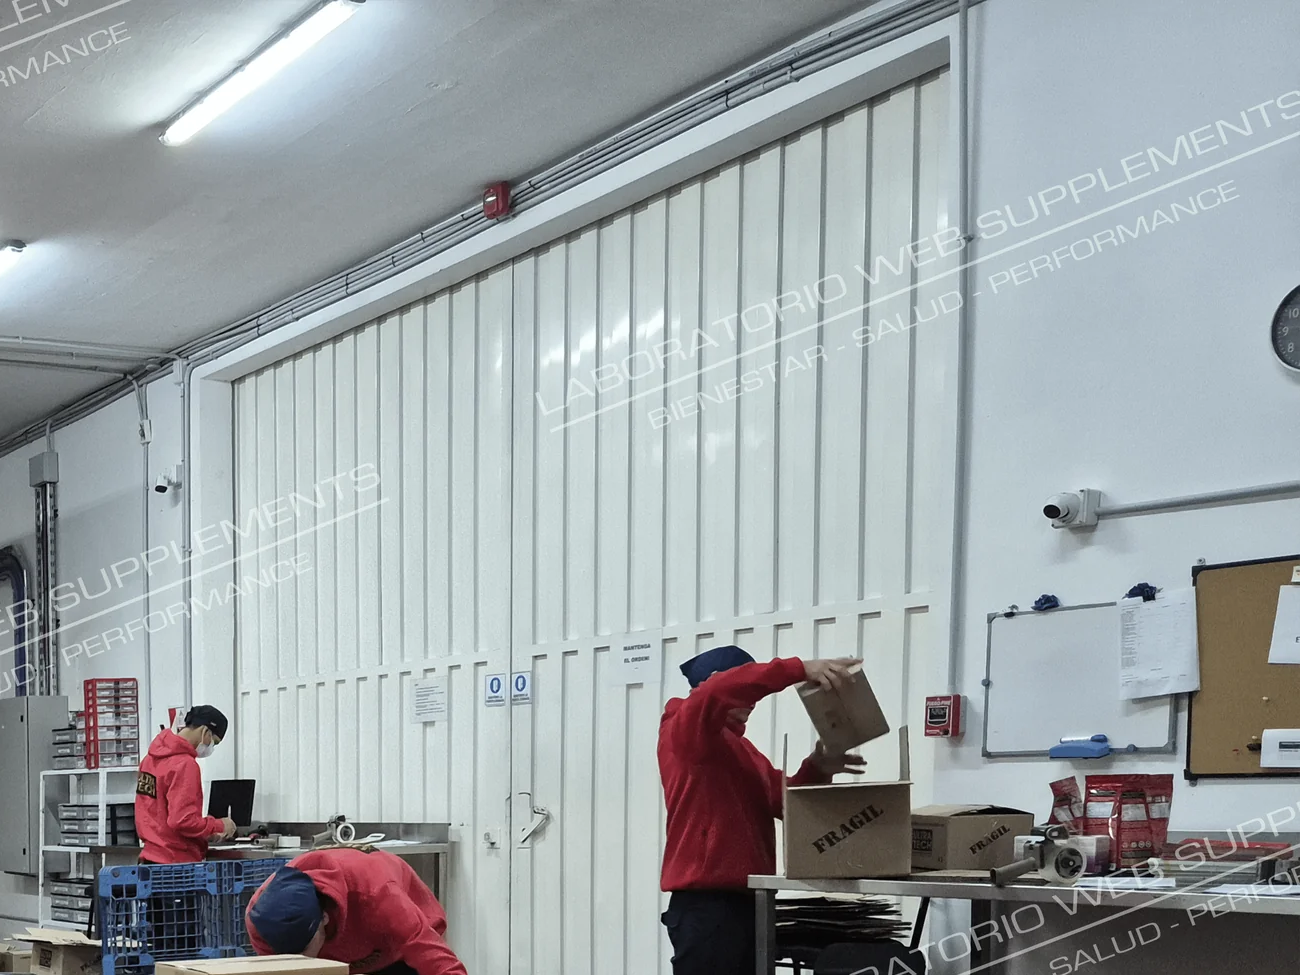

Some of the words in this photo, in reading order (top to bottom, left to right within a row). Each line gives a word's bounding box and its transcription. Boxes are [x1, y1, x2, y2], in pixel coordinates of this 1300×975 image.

[1288, 307, 1299, 319] 10
[1282, 326, 1289, 337] 9
[1287, 342, 1295, 353] 8
[812, 804, 884, 854] FRAGIL
[969, 824, 1011, 855] FRAGIL
